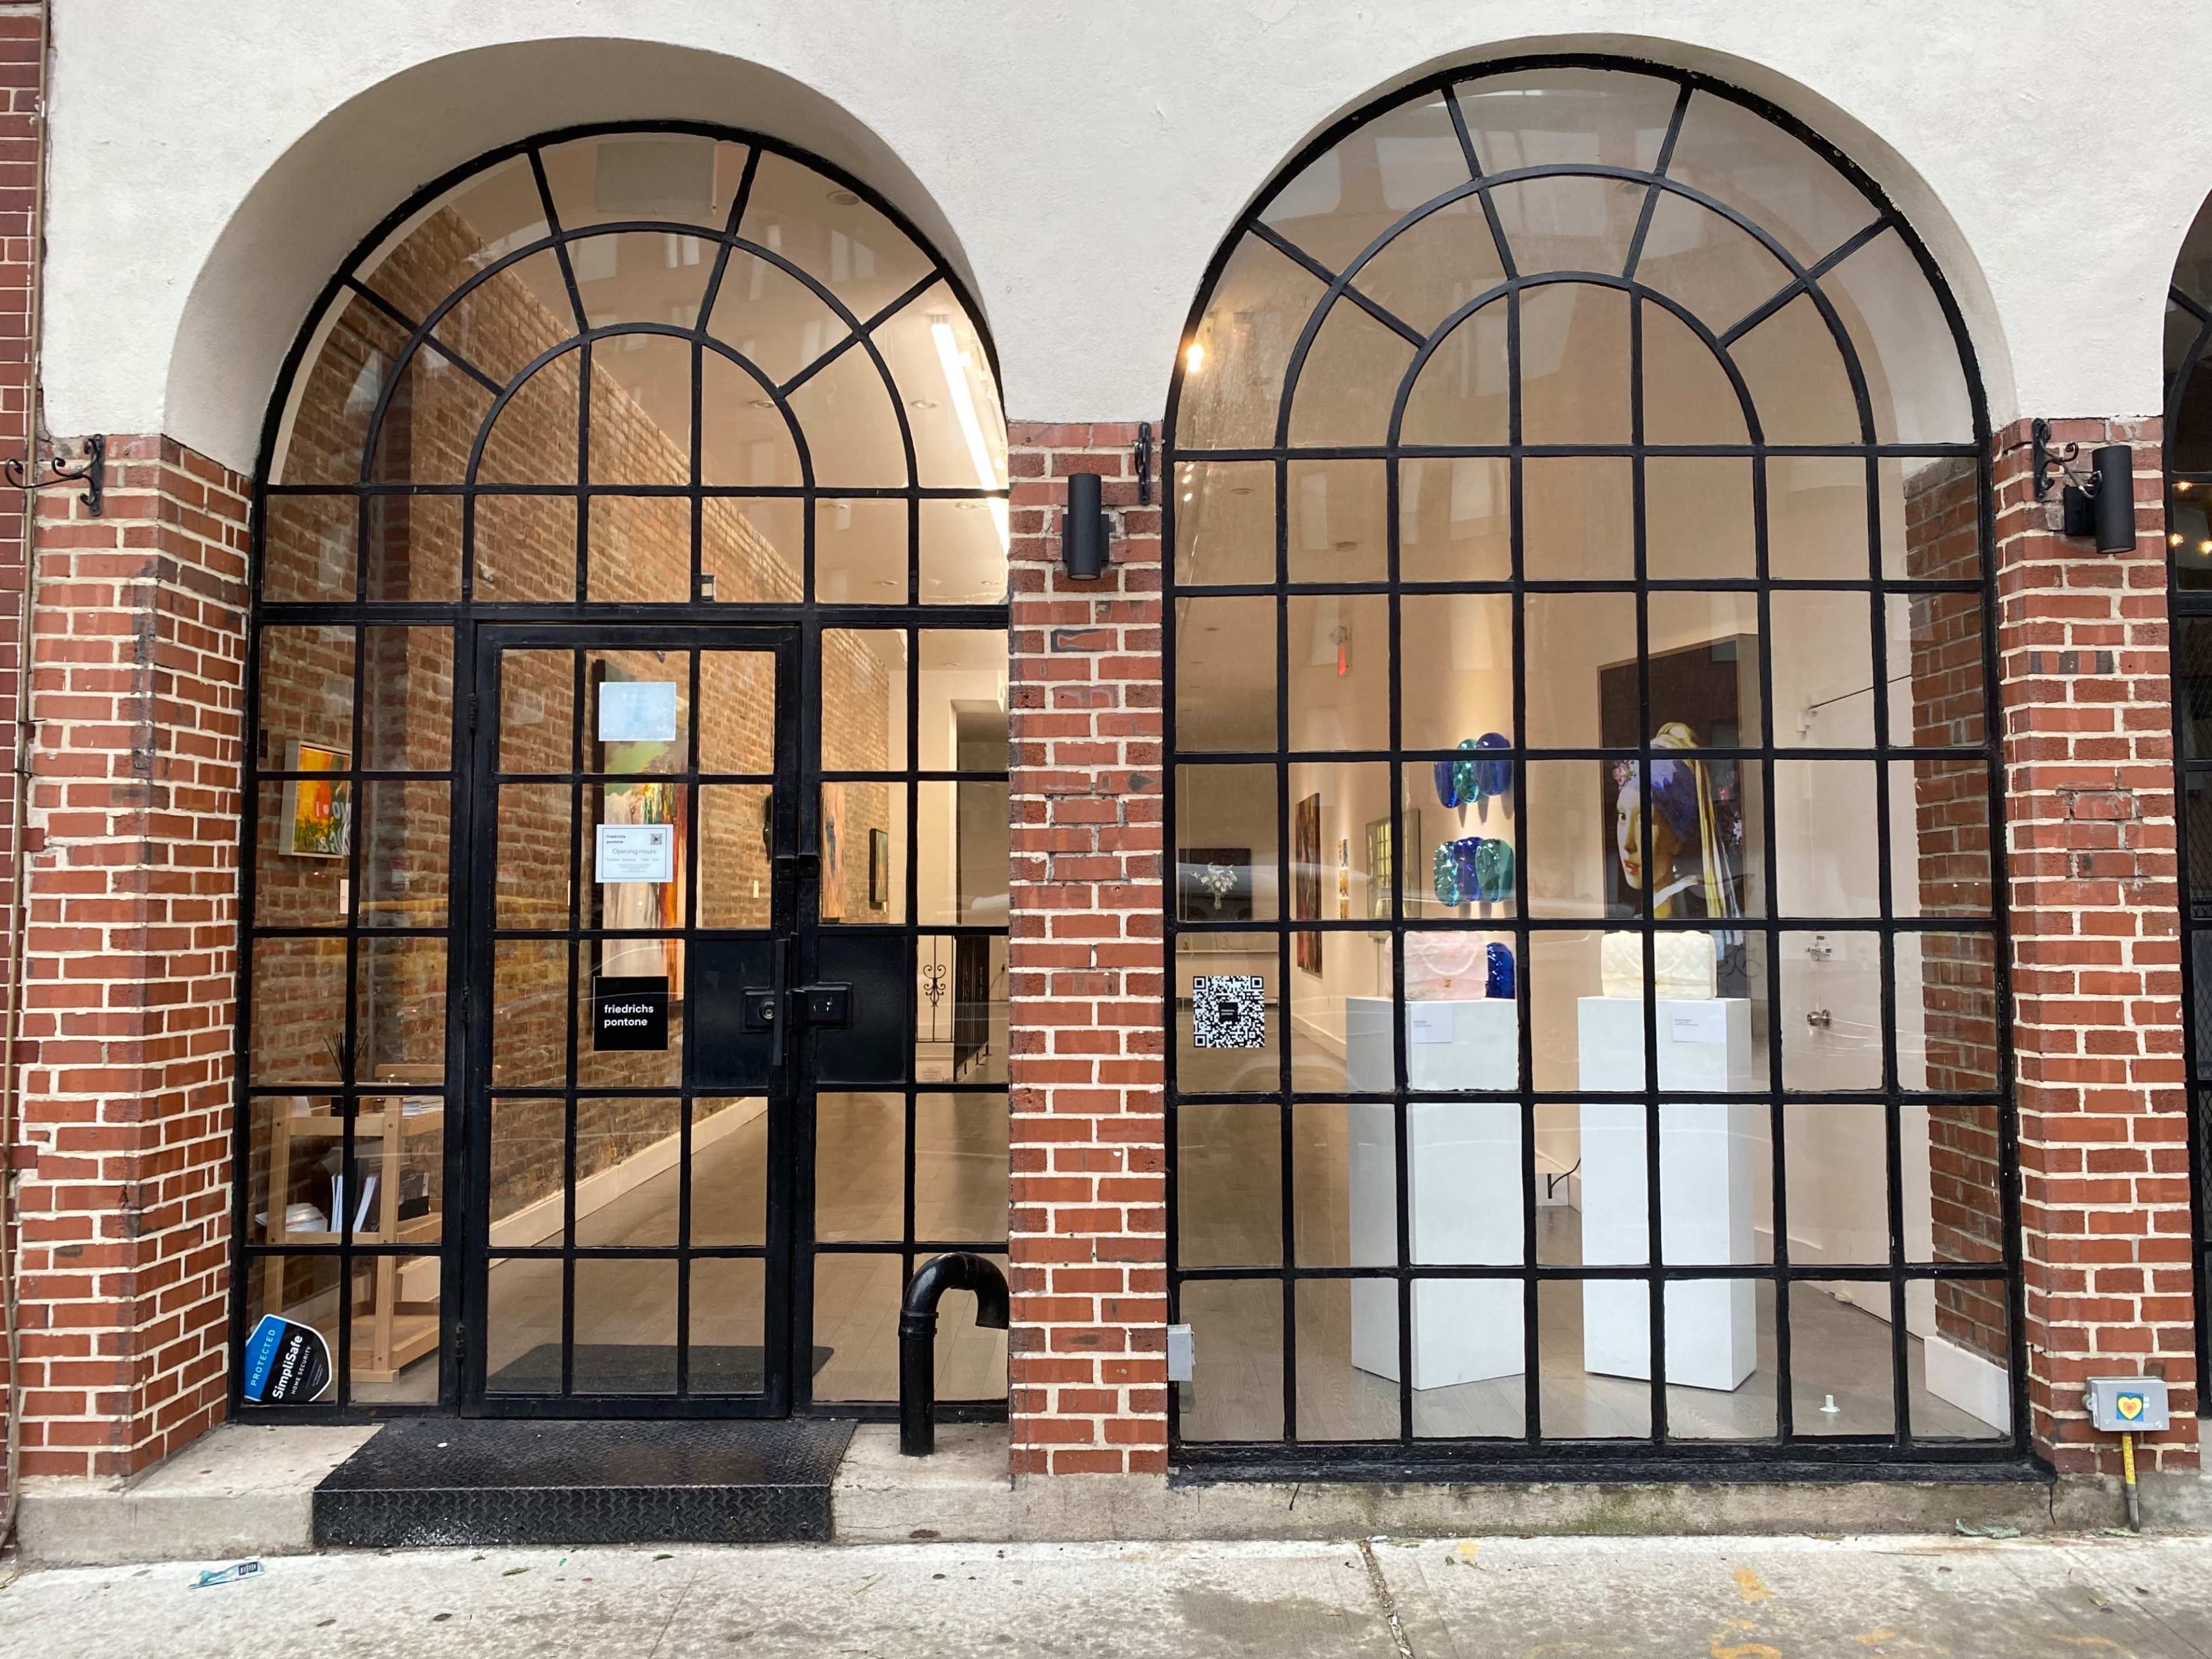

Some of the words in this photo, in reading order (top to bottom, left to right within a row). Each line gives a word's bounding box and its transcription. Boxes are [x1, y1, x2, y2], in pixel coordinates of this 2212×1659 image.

[604, 1004, 654, 1013] friedrichs
[604, 1018, 647, 1029] pontone
[250, 1330, 275, 1387] PROTECTED
[272, 1335, 303, 1399] SimpliSafe
[291, 1377, 301, 1395] HOME
[298, 1346, 312, 1376] SECURITY
